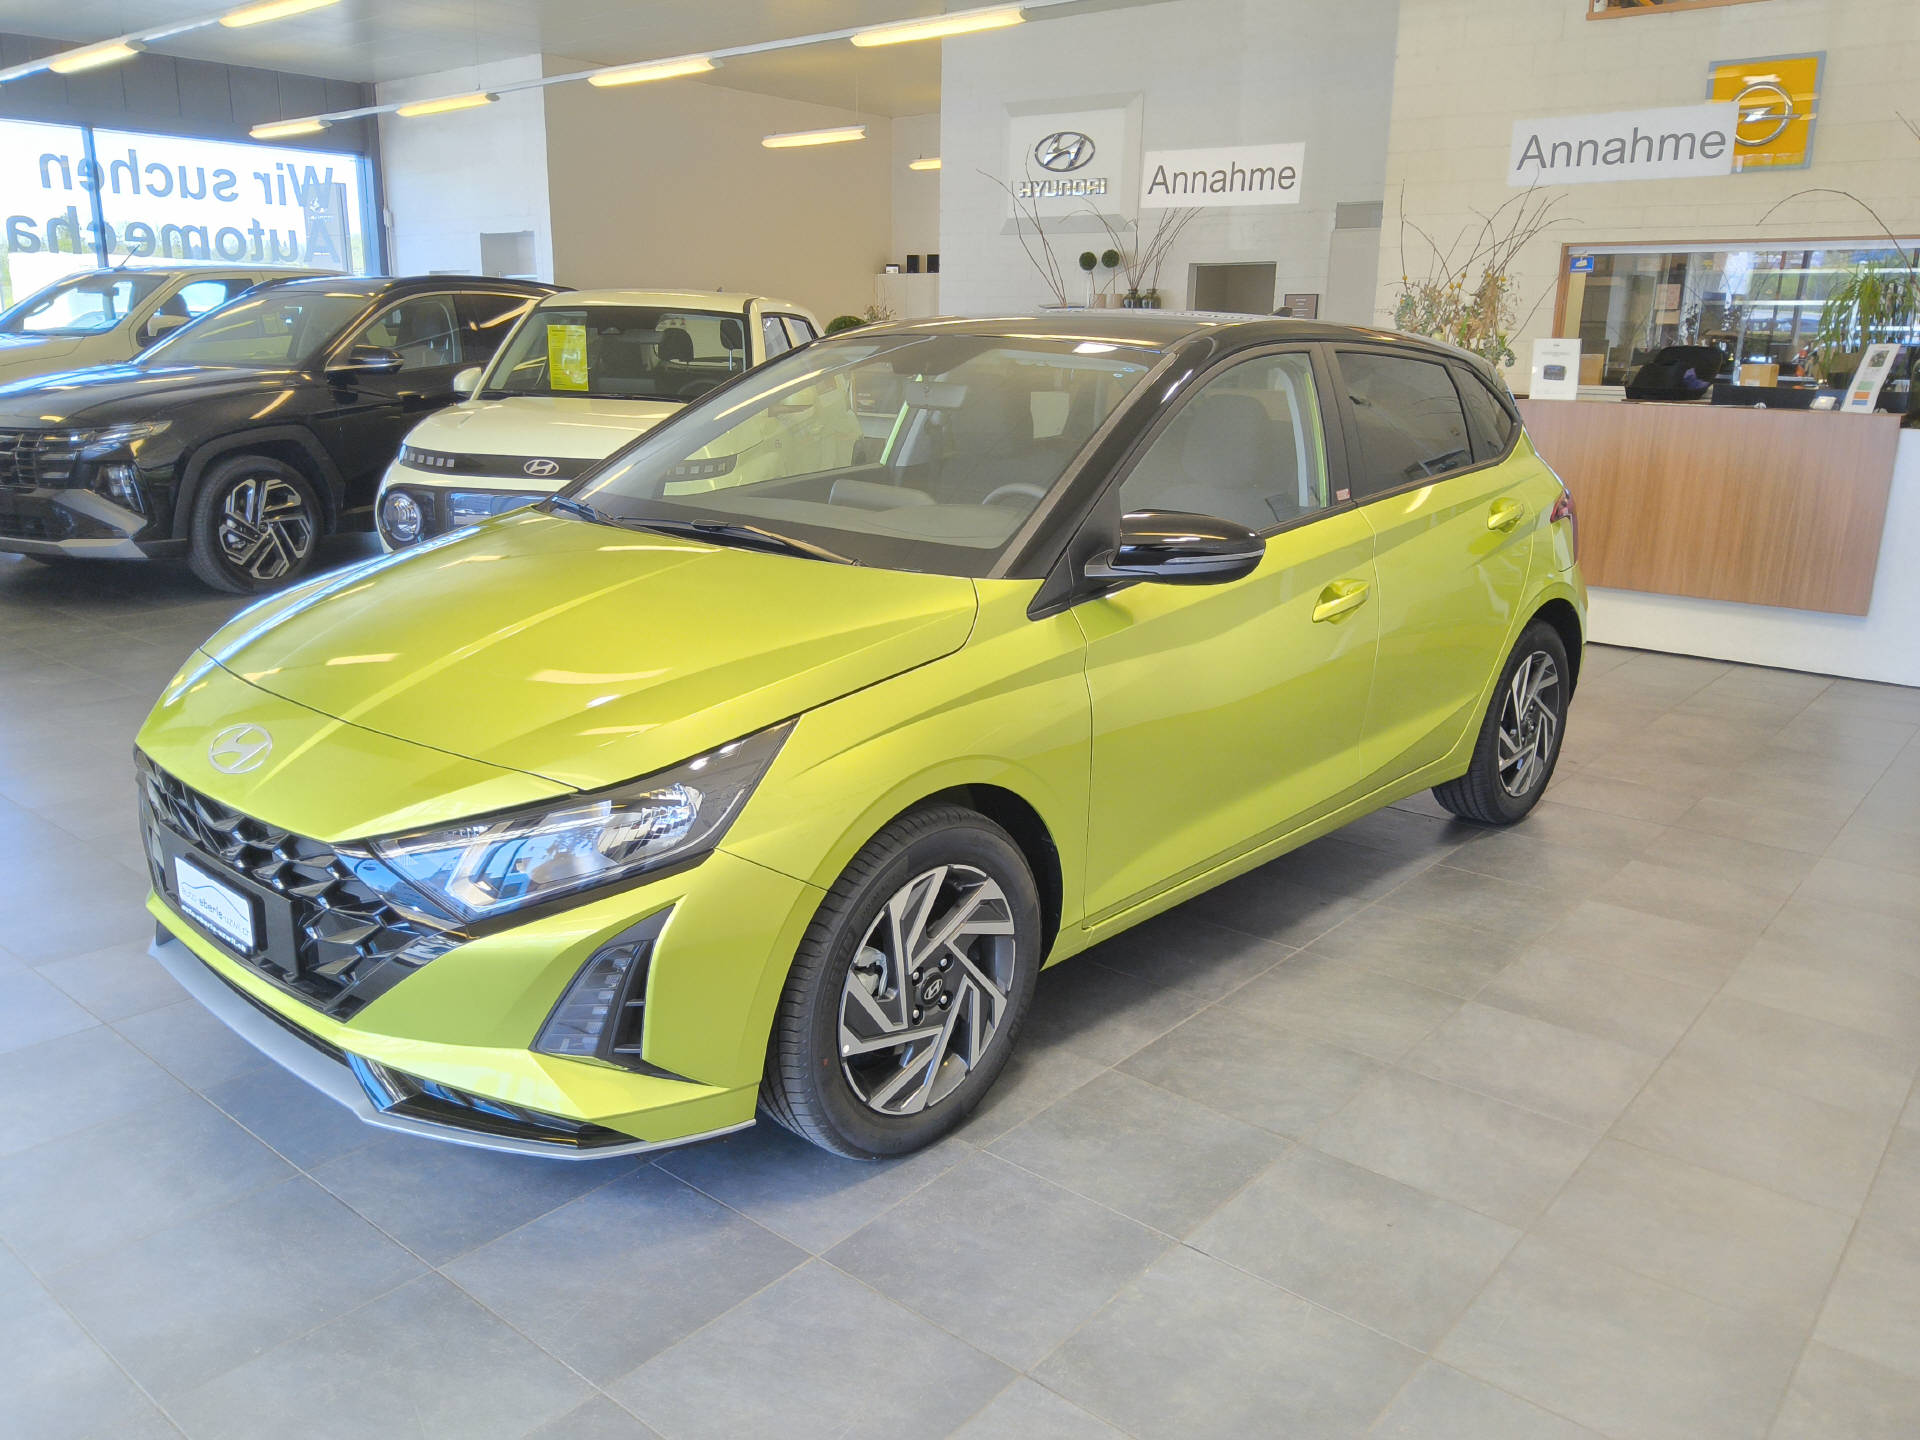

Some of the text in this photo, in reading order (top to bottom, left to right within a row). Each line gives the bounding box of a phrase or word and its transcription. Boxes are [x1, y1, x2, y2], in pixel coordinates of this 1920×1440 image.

[1516, 127, 1727, 170] Annahme
[1019, 178, 1108, 197] HYUNDAI
[1148, 161, 1296, 195] Annahme
